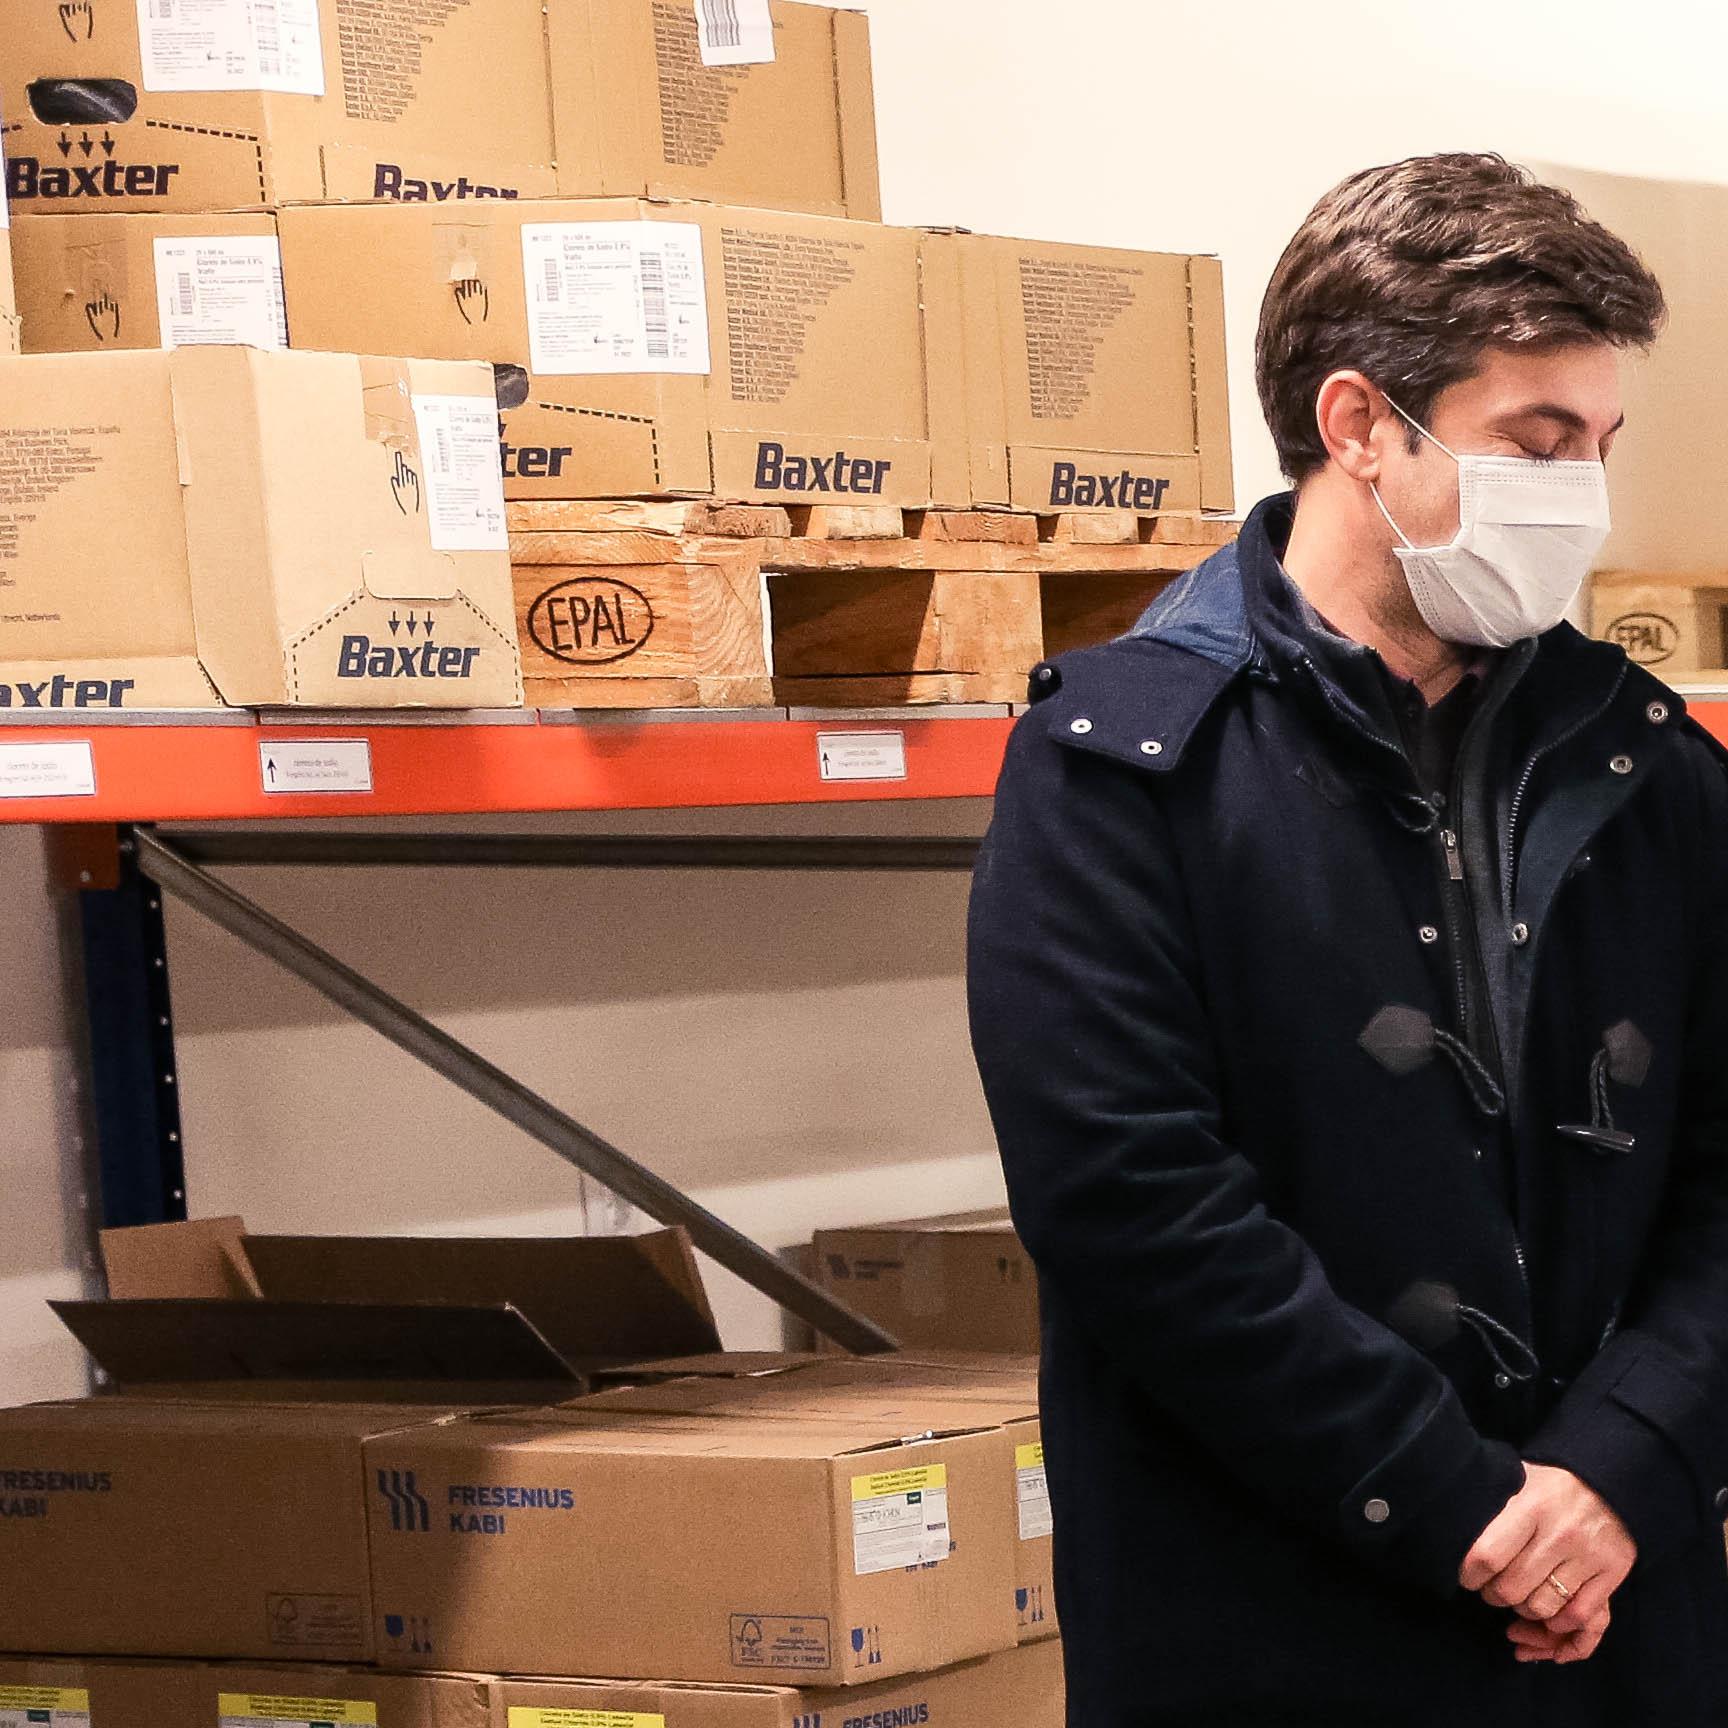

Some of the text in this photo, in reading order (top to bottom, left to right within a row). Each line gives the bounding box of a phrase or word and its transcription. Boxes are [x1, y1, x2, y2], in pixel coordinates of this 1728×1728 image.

[7, 157, 180, 200] Baxter
[756, 441, 892, 496] Baxter
[1050, 460, 1169, 511] Baxter
[546, 594, 637, 651] EPAL
[337, 634, 480, 679] Baxter
[0, 674, 135, 707] xter
[0, 1470, 112, 1492] RESENIUS
[448, 1485, 575, 1510] FRESENIUS
[449, 1513, 506, 1535] KABI
